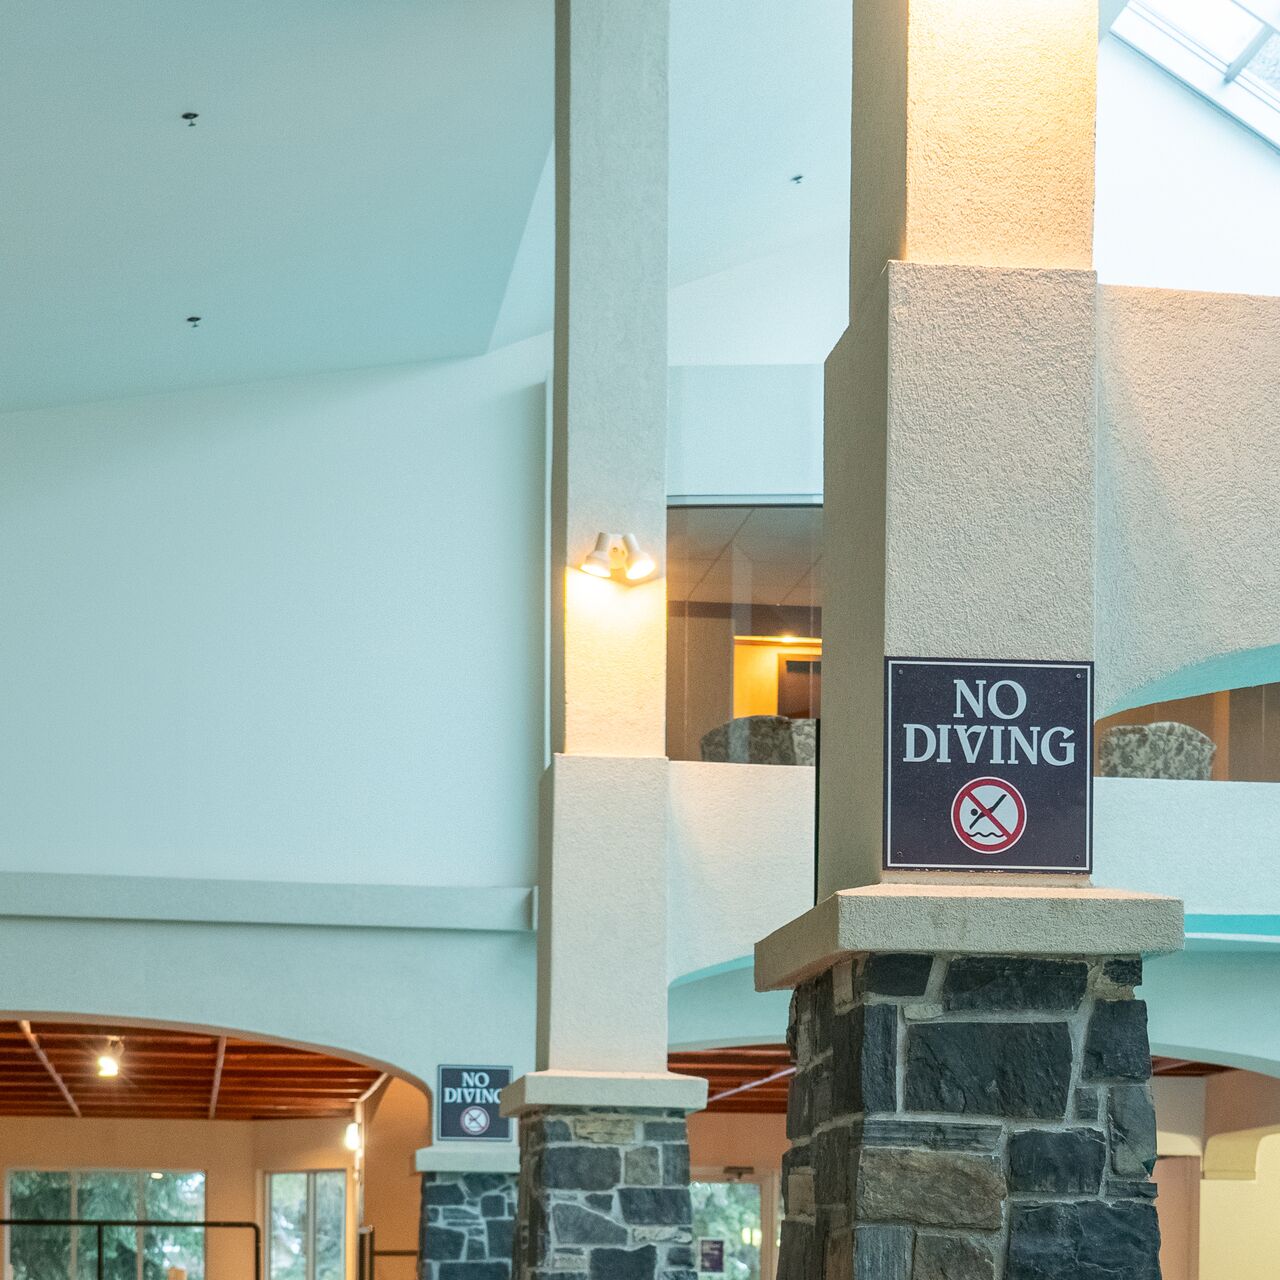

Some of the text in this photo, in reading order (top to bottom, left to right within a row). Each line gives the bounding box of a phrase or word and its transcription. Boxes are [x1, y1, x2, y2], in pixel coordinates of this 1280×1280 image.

[953, 679, 1027, 720] NO
[903, 723, 1076, 767] DIVING
[461, 1071, 490, 1088] NO
